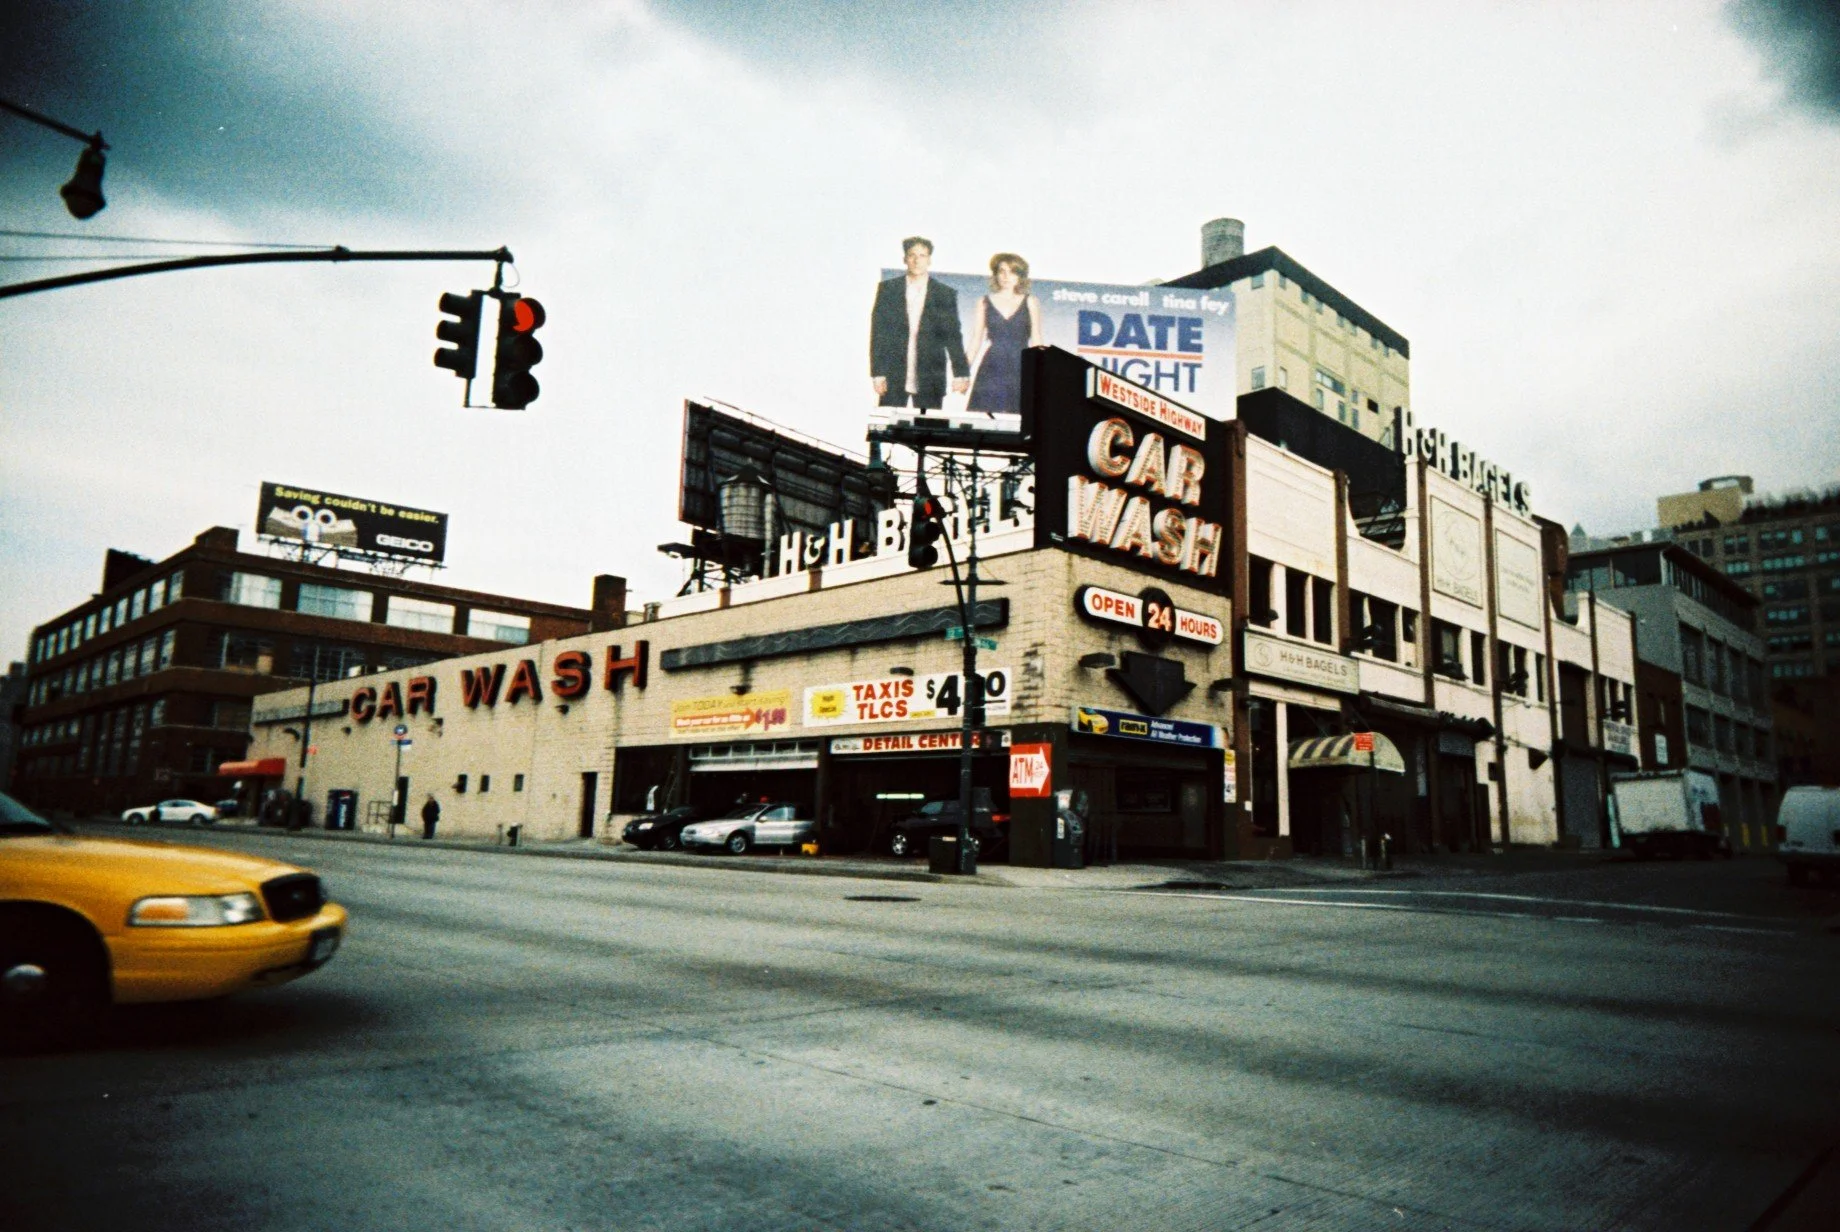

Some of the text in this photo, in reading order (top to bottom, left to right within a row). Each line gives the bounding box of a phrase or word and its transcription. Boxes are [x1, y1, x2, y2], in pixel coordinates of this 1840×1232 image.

[1052, 288, 1230, 315] steve carell tina fey
[1077, 310, 1204, 353] DATE
[1100, 374, 1204, 435] WESTSIDE HIGHWAY
[1087, 417, 1206, 506] CAR
[274, 486, 320, 505] Saving
[325, 496, 377, 514] couldn't
[380, 501, 395, 516] be
[1068, 475, 1222, 577] WASH
[375, 533, 434, 553] GEICO
[778, 518, 857, 578] H&H
[1091, 593, 1217, 639] OPEN 24 HOURS
[1280, 650, 1304, 666] H&H
[1306, 656, 1348, 677] BAGELS
[351, 640, 650, 722] CAR WASH
[852, 679, 914, 701] TAXIS
[857, 699, 908, 720] TLCS
[863, 735, 914, 751] DETAIL
[918, 731, 981, 749] CENTR
[1012, 757, 1034, 785] ATM
